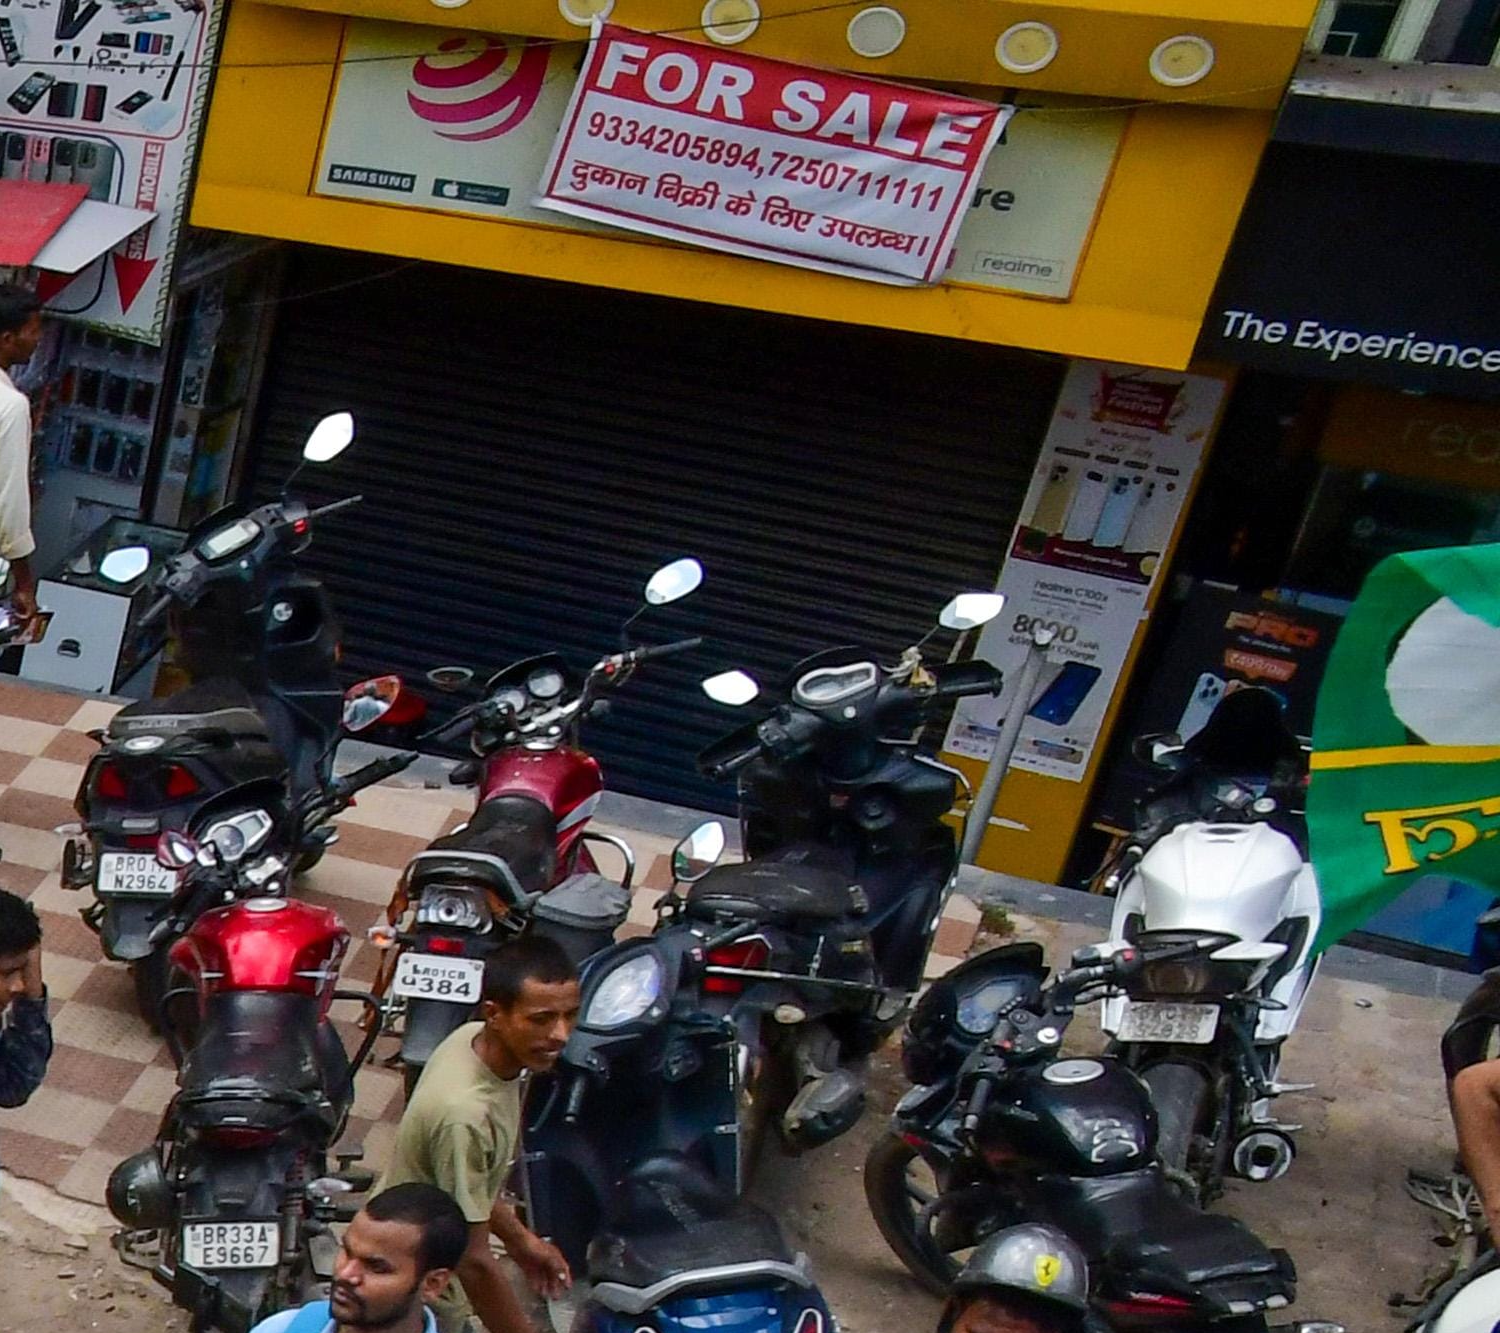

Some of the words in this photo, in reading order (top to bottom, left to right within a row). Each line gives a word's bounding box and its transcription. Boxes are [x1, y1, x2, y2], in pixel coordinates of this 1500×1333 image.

[596, 40, 755, 120] FOR
[771, 80, 984, 166] SALE
[140, 142, 161, 201] MOBILE
[331, 168, 411, 189] SAMSUNG
[571, 159, 650, 197] दुकान
[653, 171, 721, 210] बिक्री
[725, 188, 757, 219] के
[760, 199, 814, 235] लिए
[982, 256, 1053, 278] realme
[1223, 310, 1287, 343] The
[1293, 320, 1500, 372] Experience
[203, 1225, 269, 1245] BR33A
[203, 1245, 269, 1265] E9667
